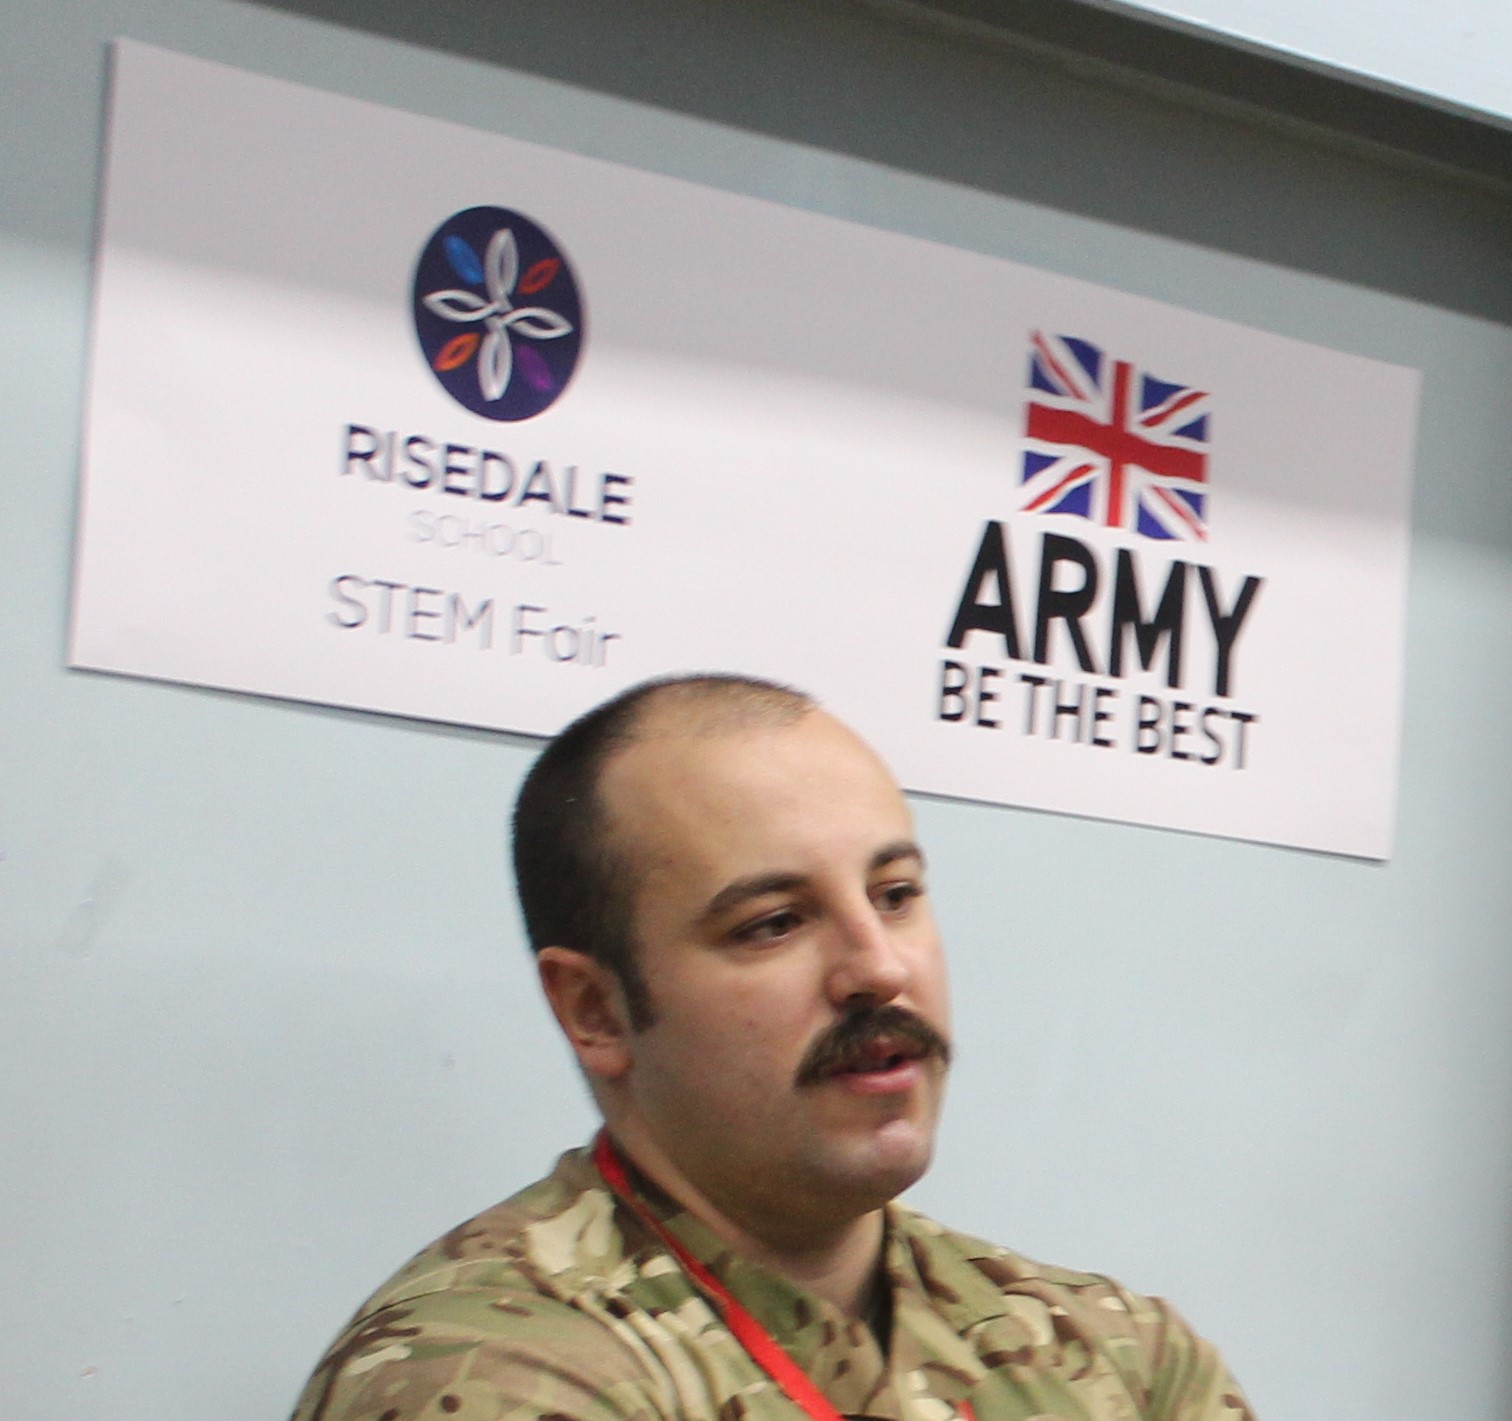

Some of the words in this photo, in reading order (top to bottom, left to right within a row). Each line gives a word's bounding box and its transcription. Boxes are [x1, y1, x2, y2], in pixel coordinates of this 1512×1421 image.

[340, 424, 634, 525] RISEDALE
[409, 509, 565, 566] SCHOOL
[327, 574, 495, 651] STEM
[511, 603, 622, 668] Fair
[944, 519, 1265, 698] ARMY
[937, 659, 1003, 730] BE
[1015, 673, 1119, 750] THE
[1133, 693, 1258, 772] BEST
